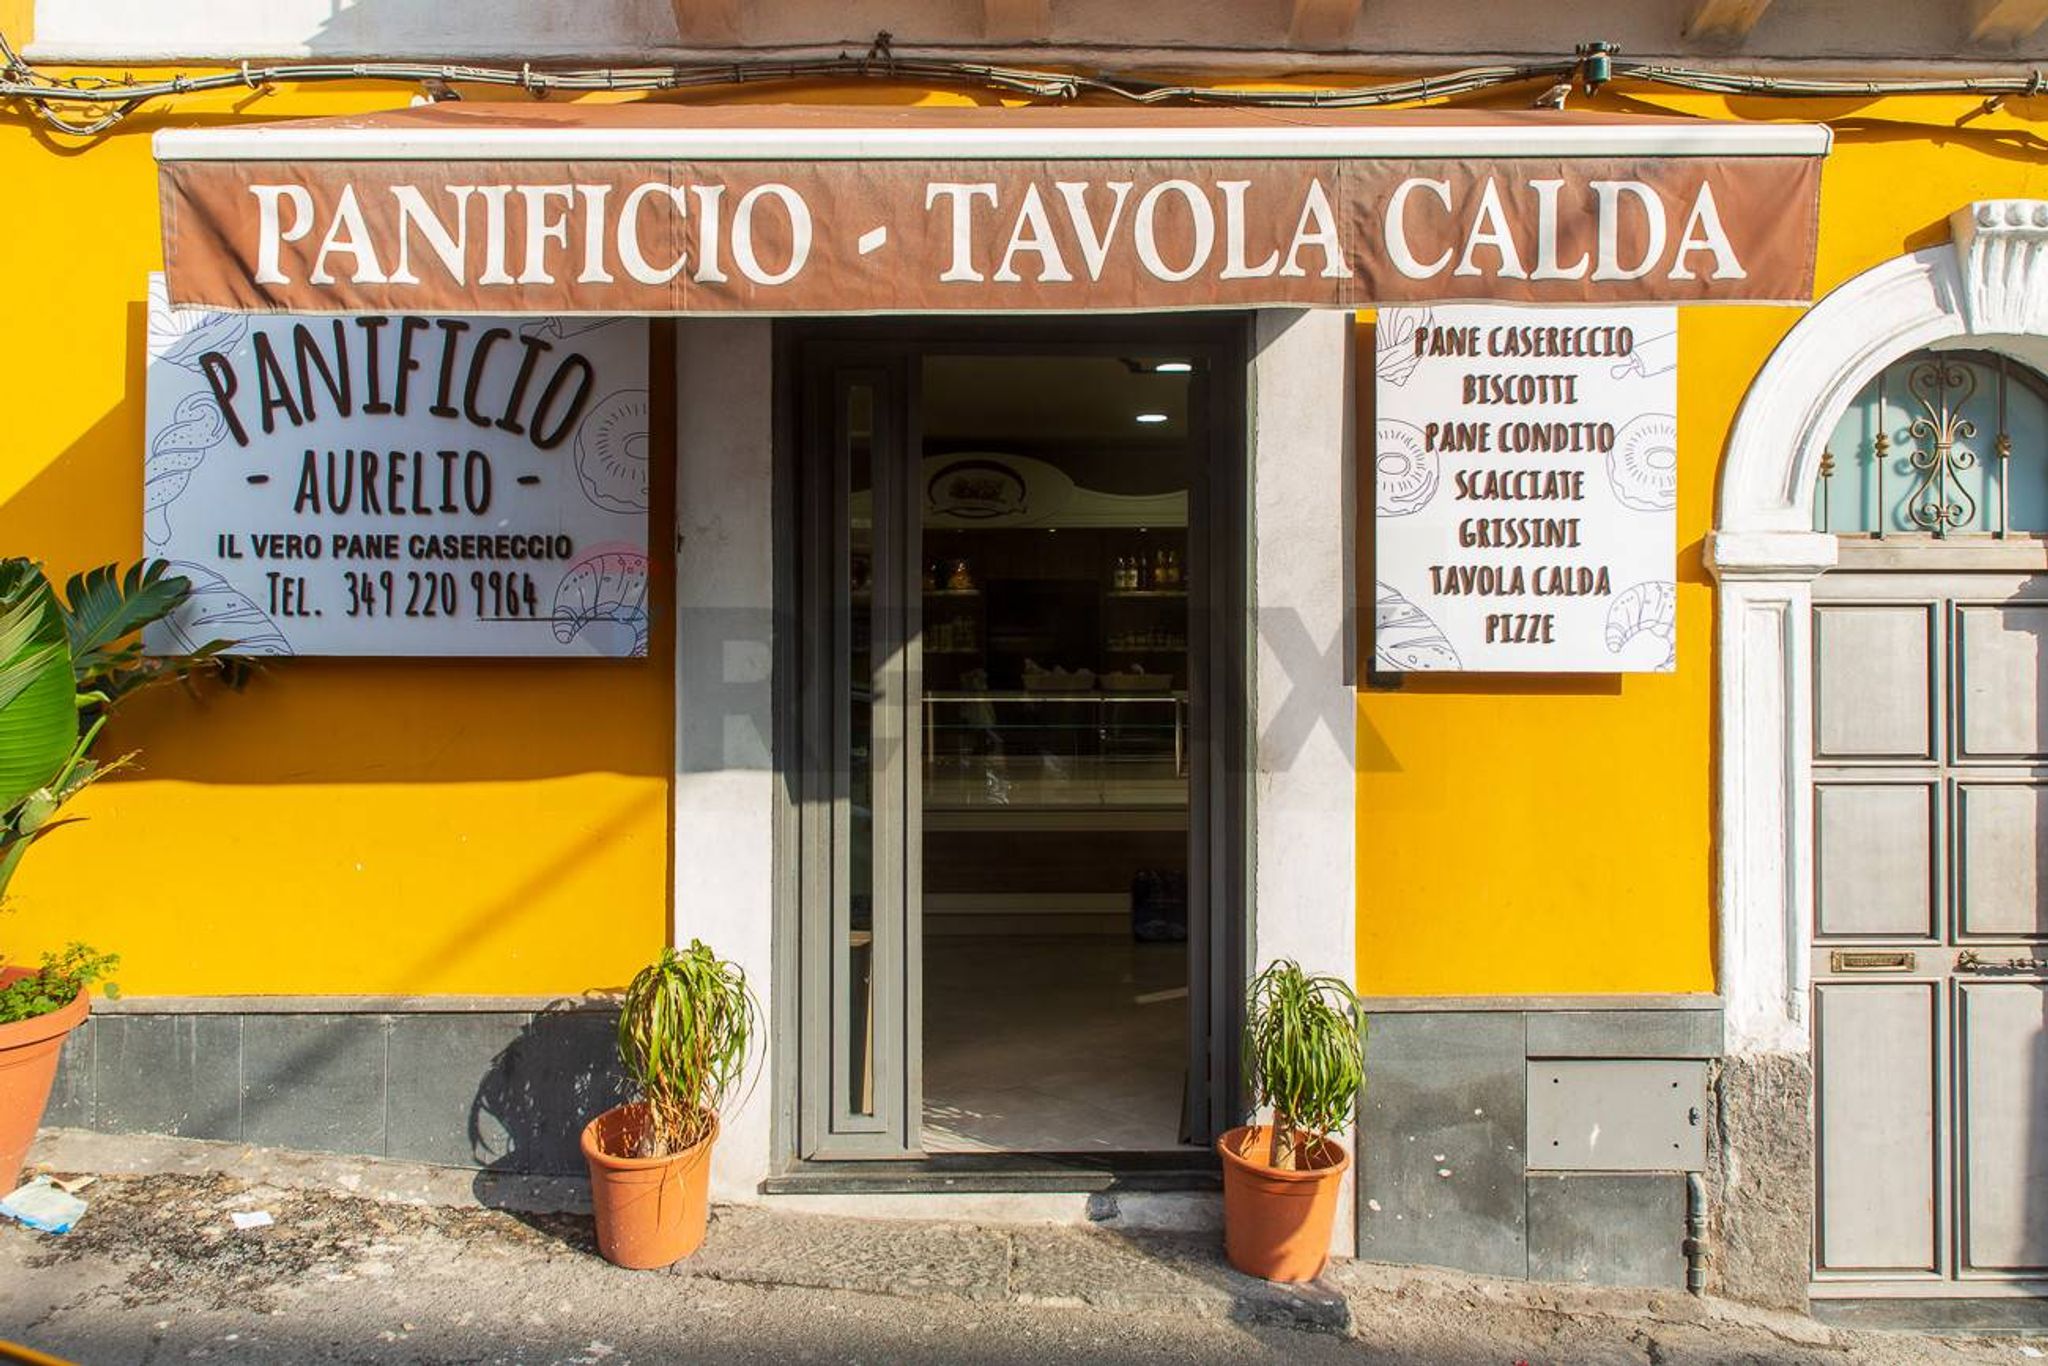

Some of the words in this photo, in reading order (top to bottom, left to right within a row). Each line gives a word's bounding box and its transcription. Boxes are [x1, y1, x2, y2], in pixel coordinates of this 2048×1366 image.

[248, 182, 813, 287] PANIFICIO
[925, 177, 1354, 284] TAVOLA
[1381, 176, 1748, 283] CALDA
[1414, 325, 1480, 358] PANE
[1488, 325, 1634, 358] CASERECCIO
[199, 315, 595, 450] PANIFICIO
[1462, 373, 1579, 405] BISCOTTI
[1424, 422, 1491, 454] PANE
[1498, 421, 1616, 454] CONDITO
[293, 449, 493, 517] AURELIO
[1454, 469, 1586, 502] SCACCIATE
[217, 534, 243, 559] IL
[250, 534, 323, 560] VERO
[331, 534, 400, 560] PANE
[408, 534, 574, 561] CASERECCIO
[1458, 518, 1582, 549] GRISSINI
[345, 571, 394, 618] 349
[405, 571, 457, 617] 220
[471, 571, 538, 618] 9964
[1429, 565, 1526, 597] TAVOLA
[1532, 566, 1612, 597] CALDA
[1485, 614, 1555, 645] PIZZE
